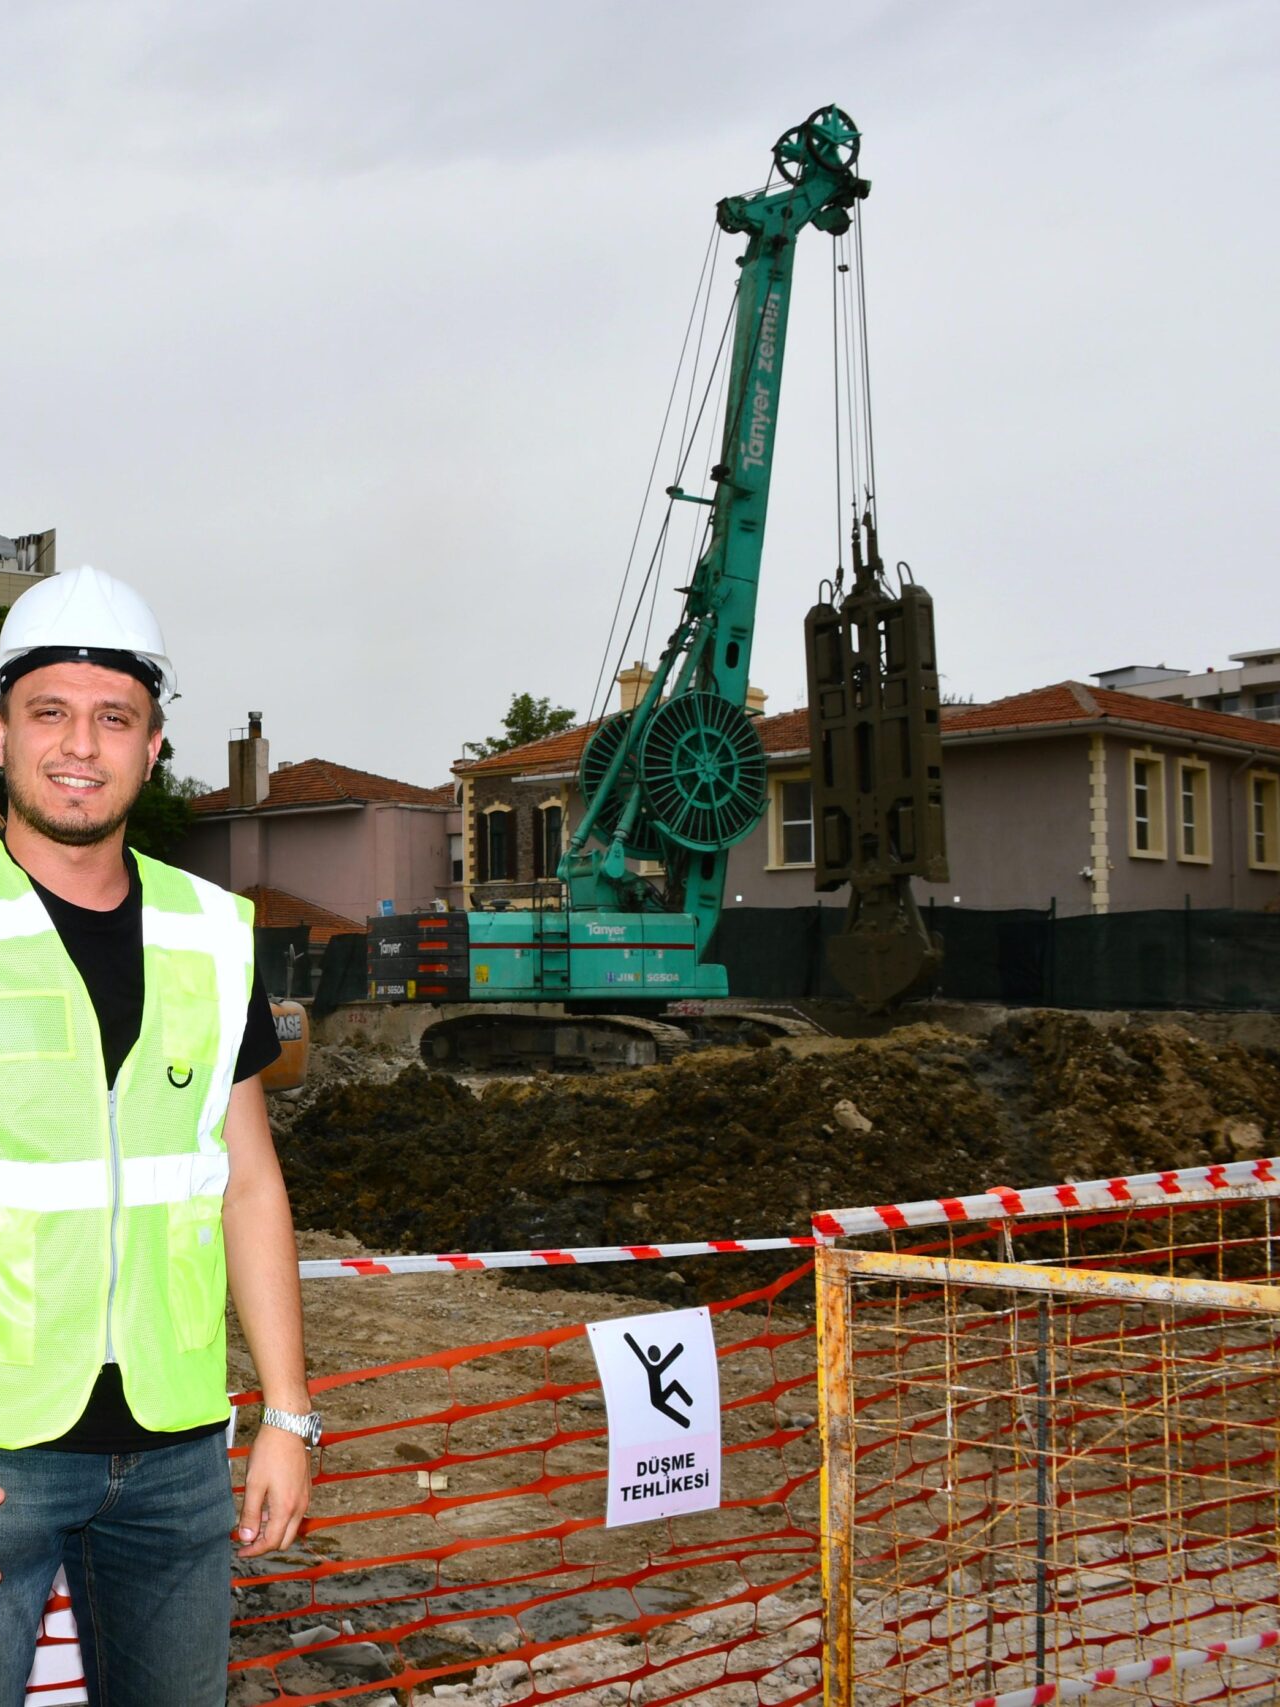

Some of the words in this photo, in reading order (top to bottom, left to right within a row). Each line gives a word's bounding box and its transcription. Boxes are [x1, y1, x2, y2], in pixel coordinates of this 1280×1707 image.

[740, 380, 770, 472] Tanyer
[758, 293, 781, 372] zemin
[586, 922, 626, 936] Tanyer
[379, 939, 401, 956] Tanyer
[637, 1452, 695, 1477] DÜŞME
[620, 1468, 709, 1502] TEHLİKESİ
